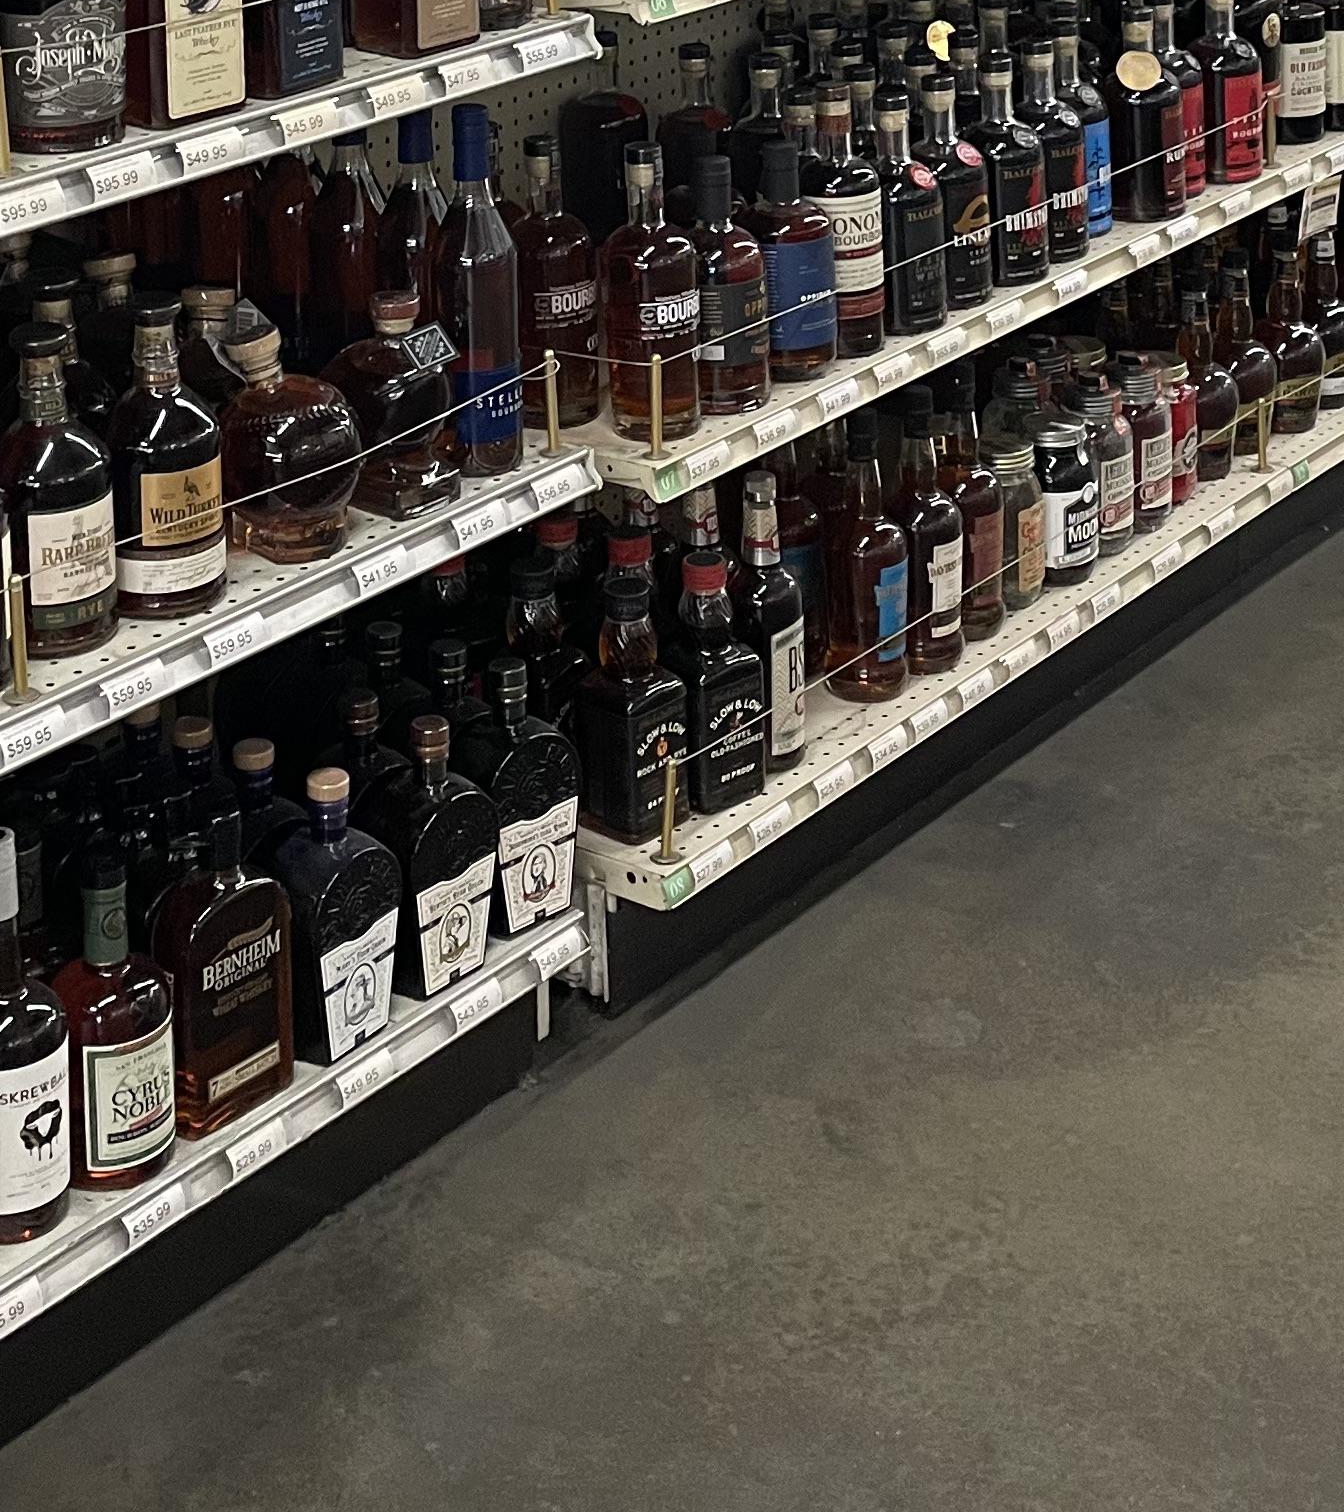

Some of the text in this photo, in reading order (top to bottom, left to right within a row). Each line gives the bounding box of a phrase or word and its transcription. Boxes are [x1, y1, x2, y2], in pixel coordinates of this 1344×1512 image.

[284, 113, 325, 138] $45.99
[186, 143, 229, 167] $49.95
[95, 169, 139, 195] $95.99
[0, 197, 49, 224] $95.99
[150, 504, 184, 525] WILD
[460, 514, 495, 542] $41.95
[362, 560, 399, 589] $41.95
[76, 599, 105, 622] RYE
[212, 628, 254, 660] $59.95
[111, 676, 154, 708] $59.95
[709, 698, 763, 731] SLOW & LOW
[6, 726, 54, 760] $59.95
[636, 728, 660, 757] SLOW
[667, 720, 688, 737] LOW
[636, 761, 657, 779] ROCK
[730, 762, 756, 780] PROOF
[201, 928, 282, 993] BERNHEIM
[214, 954, 271, 991] ORIGINAL
[110, 1070, 171, 1107] CYRUS
[111, 1092, 173, 1124] NOBLE
[234, 1138, 273, 1174] $29.99
[131, 1200, 173, 1239] $35.99
